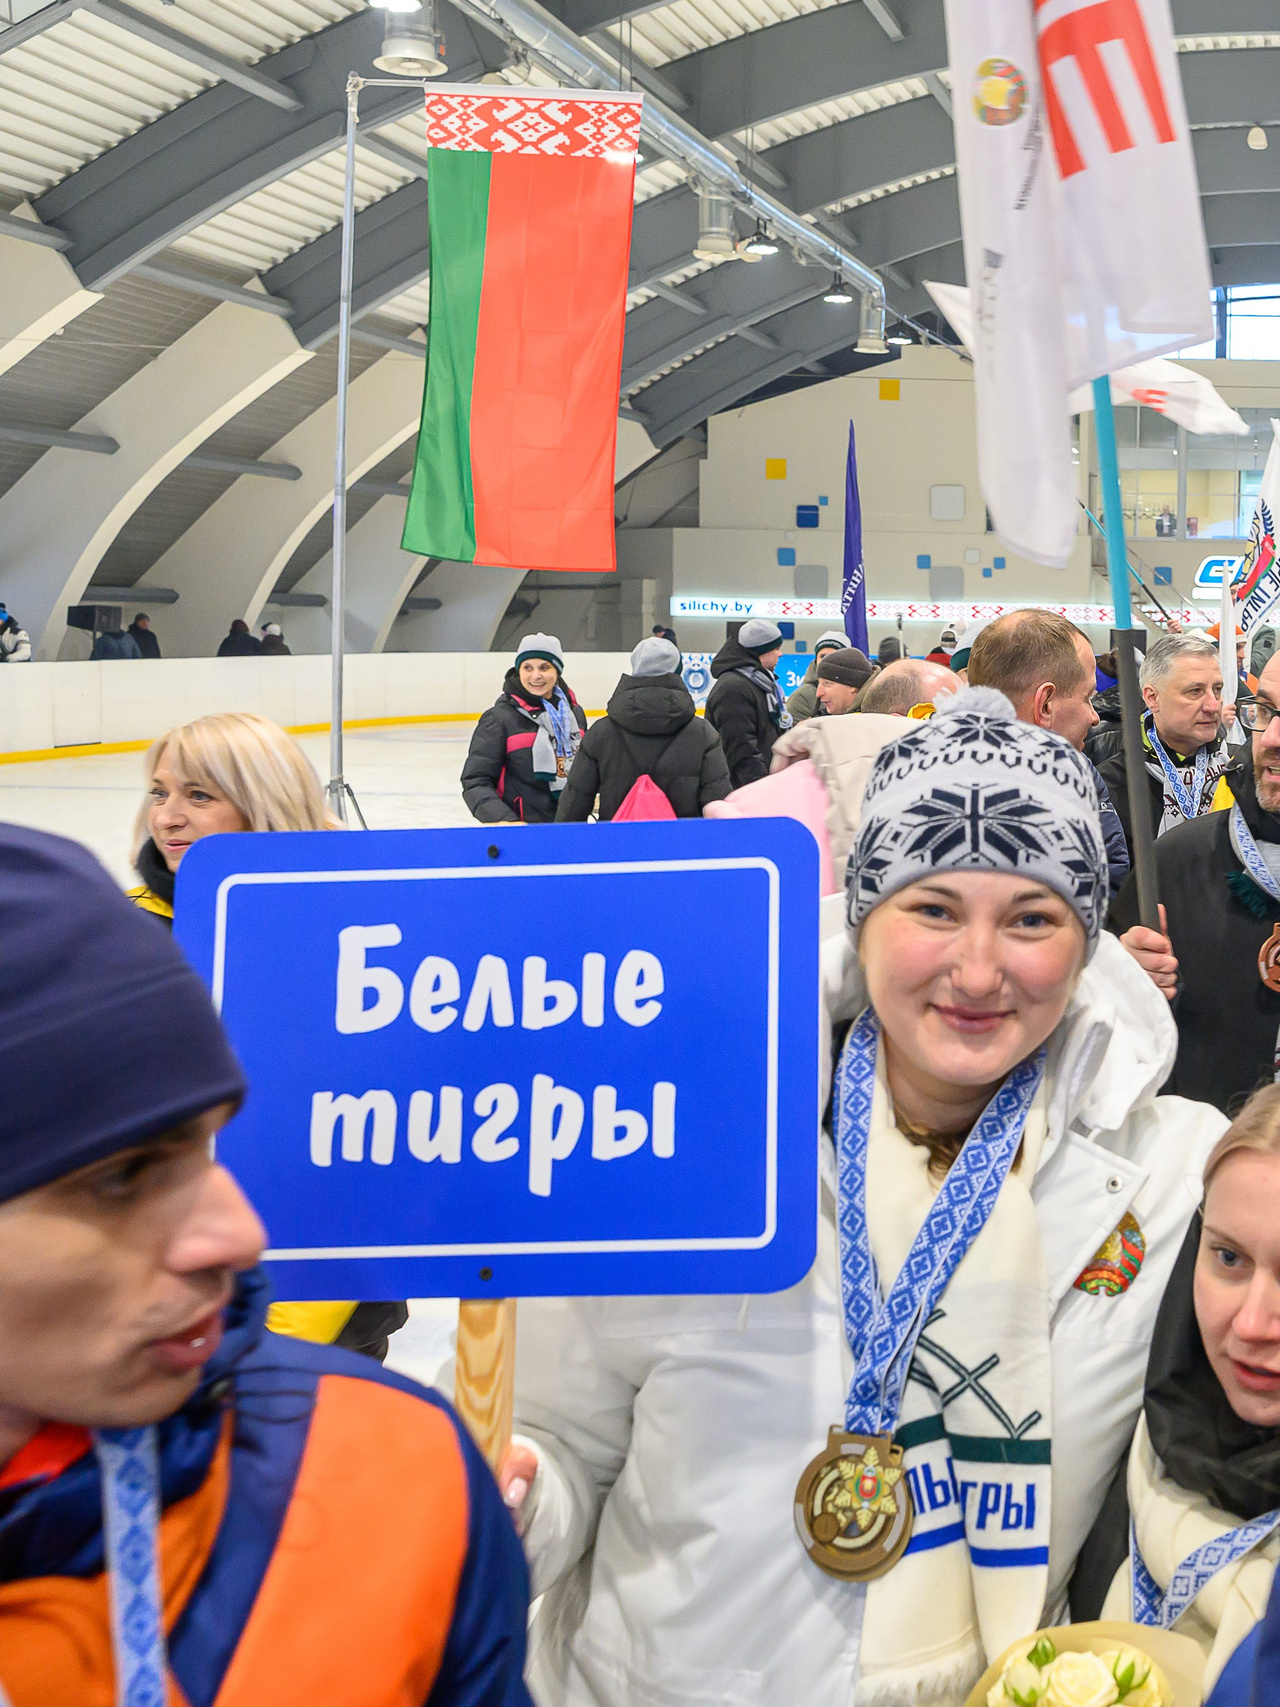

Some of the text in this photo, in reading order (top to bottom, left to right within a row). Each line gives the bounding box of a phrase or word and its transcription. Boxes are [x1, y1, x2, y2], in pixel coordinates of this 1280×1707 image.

[680, 600, 753, 614] silichy.by
[335, 924, 665, 1034] Белые
[309, 1073, 677, 1197] тигры
[960, 1480, 1036, 1532] ГРЫ
